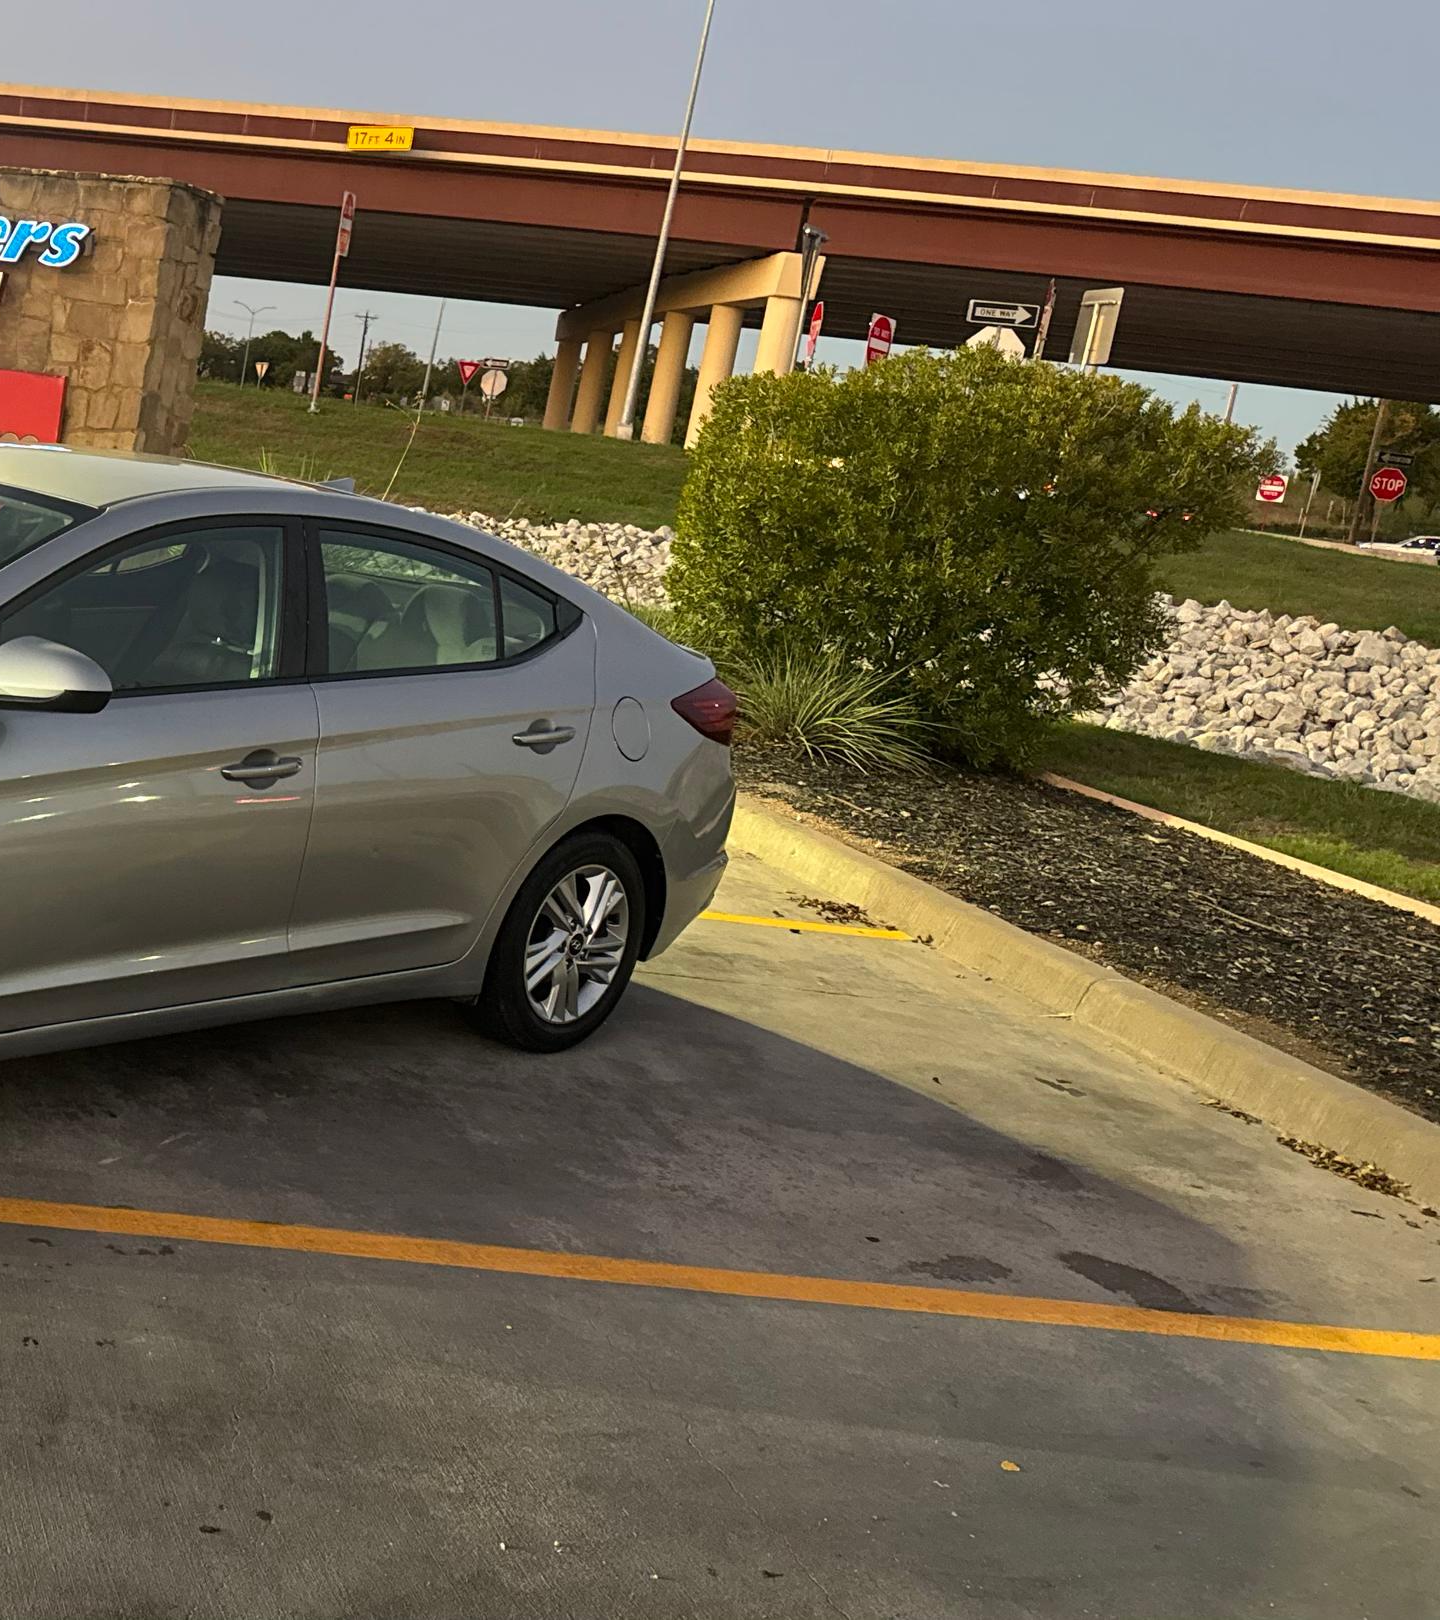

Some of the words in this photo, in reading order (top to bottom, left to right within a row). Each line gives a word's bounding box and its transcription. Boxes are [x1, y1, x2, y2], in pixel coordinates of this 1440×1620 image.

[980, 308, 996, 317] ONE
[999, 310, 1017, 318] WAY
[1372, 476, 1404, 492] STOP
